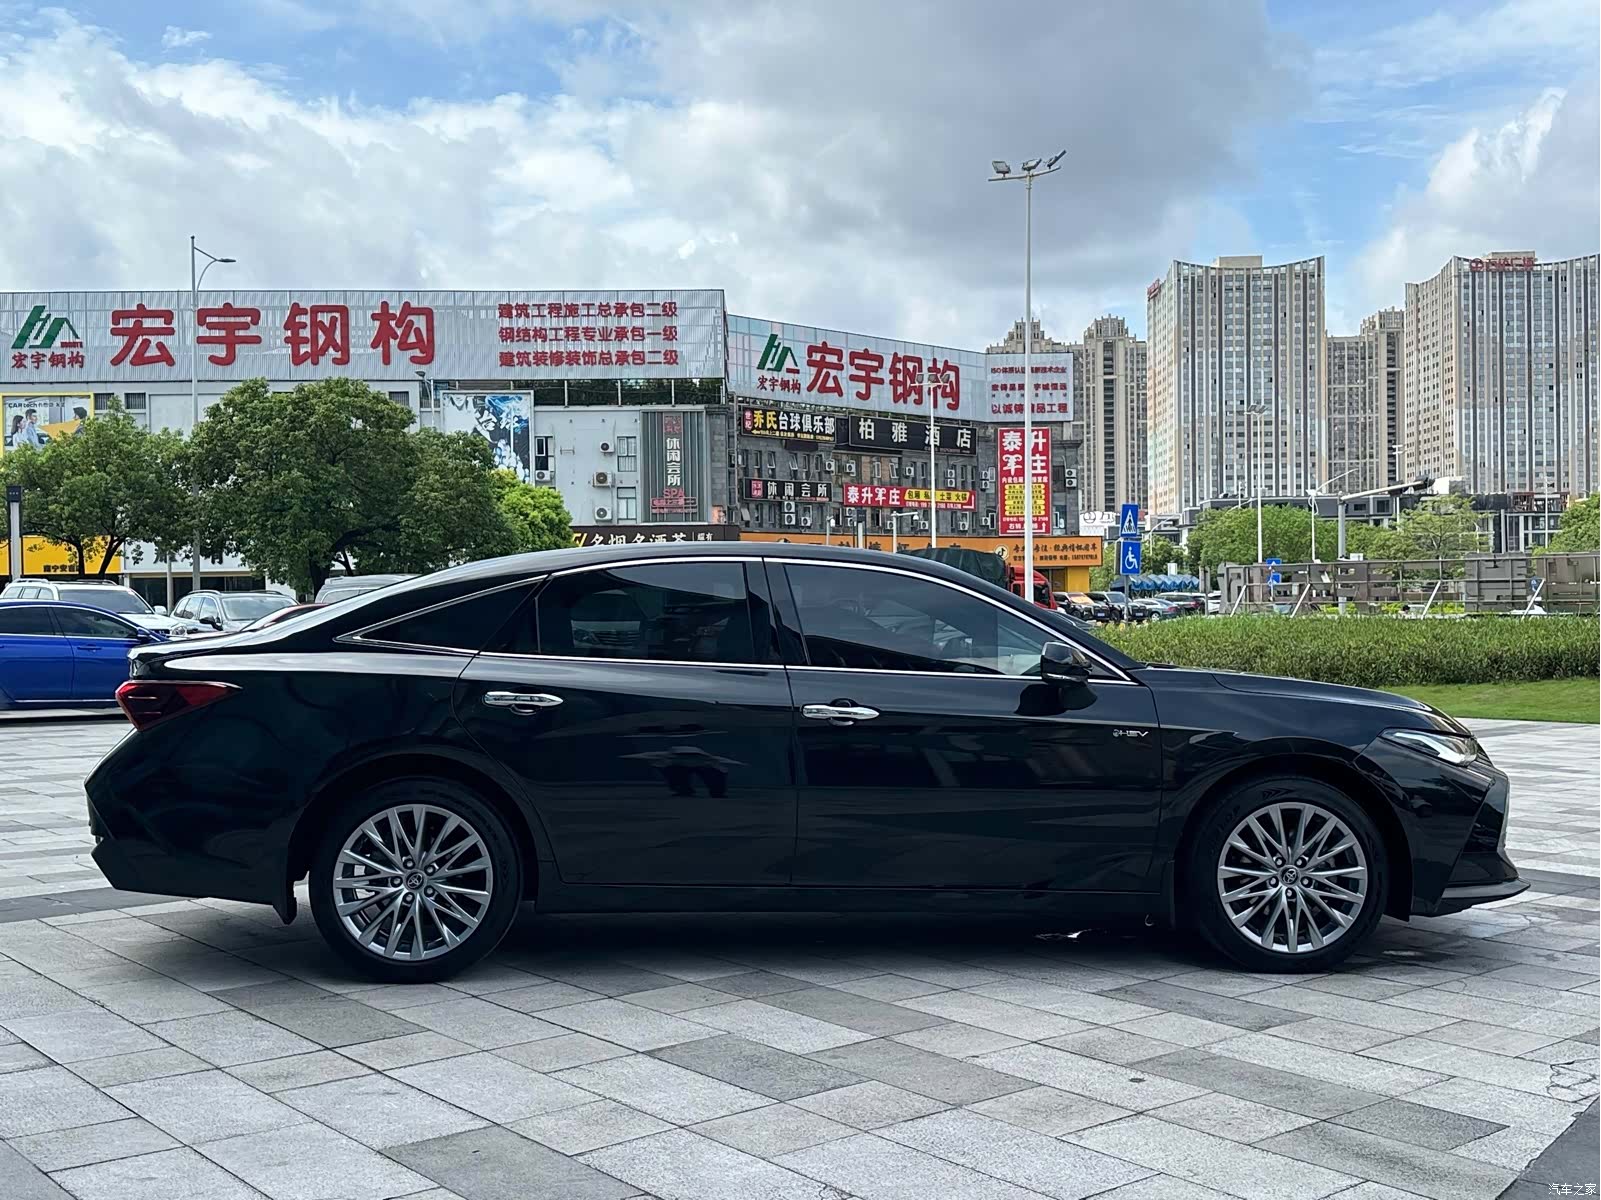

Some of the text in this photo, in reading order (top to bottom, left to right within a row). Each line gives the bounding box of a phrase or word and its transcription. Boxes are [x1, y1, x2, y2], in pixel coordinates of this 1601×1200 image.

[497, 302, 678, 319] 建筑工程施工总承包二级
[110, 301, 436, 367] 宏宇钢构
[499, 326, 678, 343] 钢结构工程专业承包一级
[11, 351, 86, 370] 宏宇钢构
[499, 349, 679, 367] 建筑装修装饰总承包二级
[757, 374, 801, 395] 宏宇钢构
[806, 341, 960, 411] 宏宇钢构
[753, 410, 835, 435] 乔氏台球俱乐部
[858, 418, 972, 448] 柏雅酒店
[666, 437, 681, 486] 休闲会所
[663, 488, 685, 498] SPA
[767, 481, 827, 498] 休闲会所
